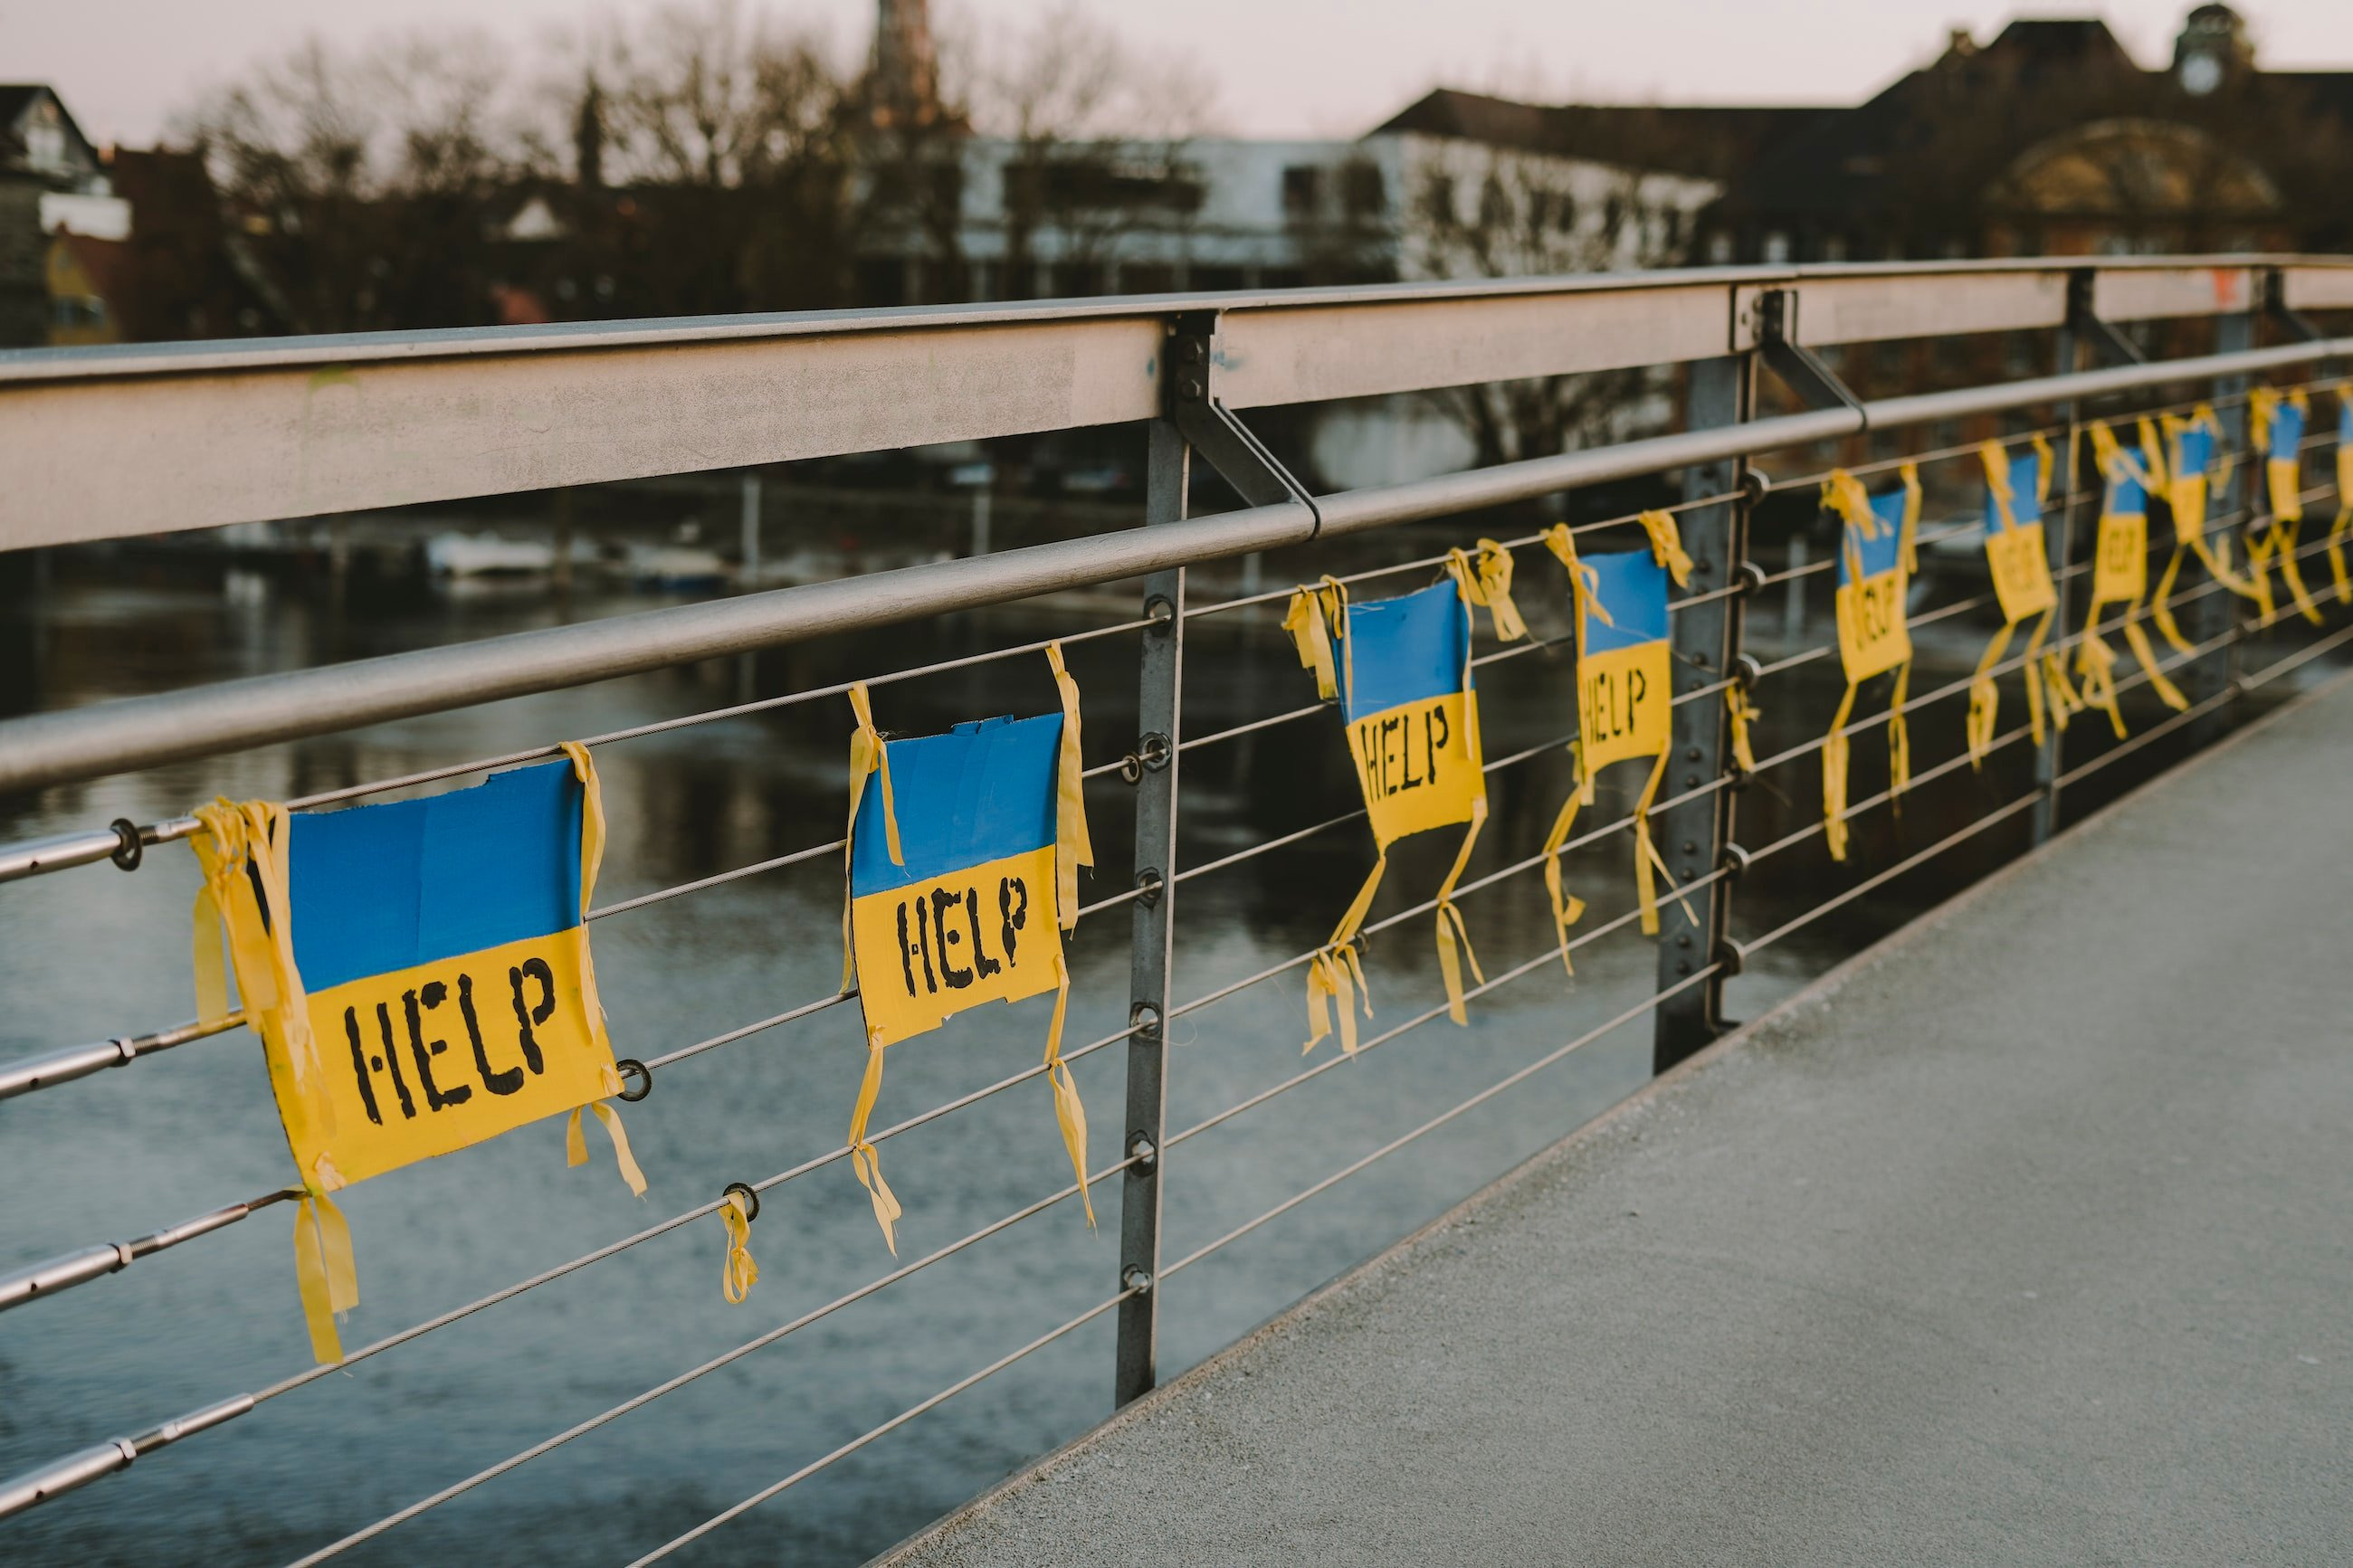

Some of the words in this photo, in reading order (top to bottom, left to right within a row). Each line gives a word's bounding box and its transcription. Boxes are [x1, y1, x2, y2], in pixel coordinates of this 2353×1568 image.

[1360, 704, 1449, 804] HELP
[897, 877, 1027, 998] HELP
[345, 957, 556, 1126] HELP
